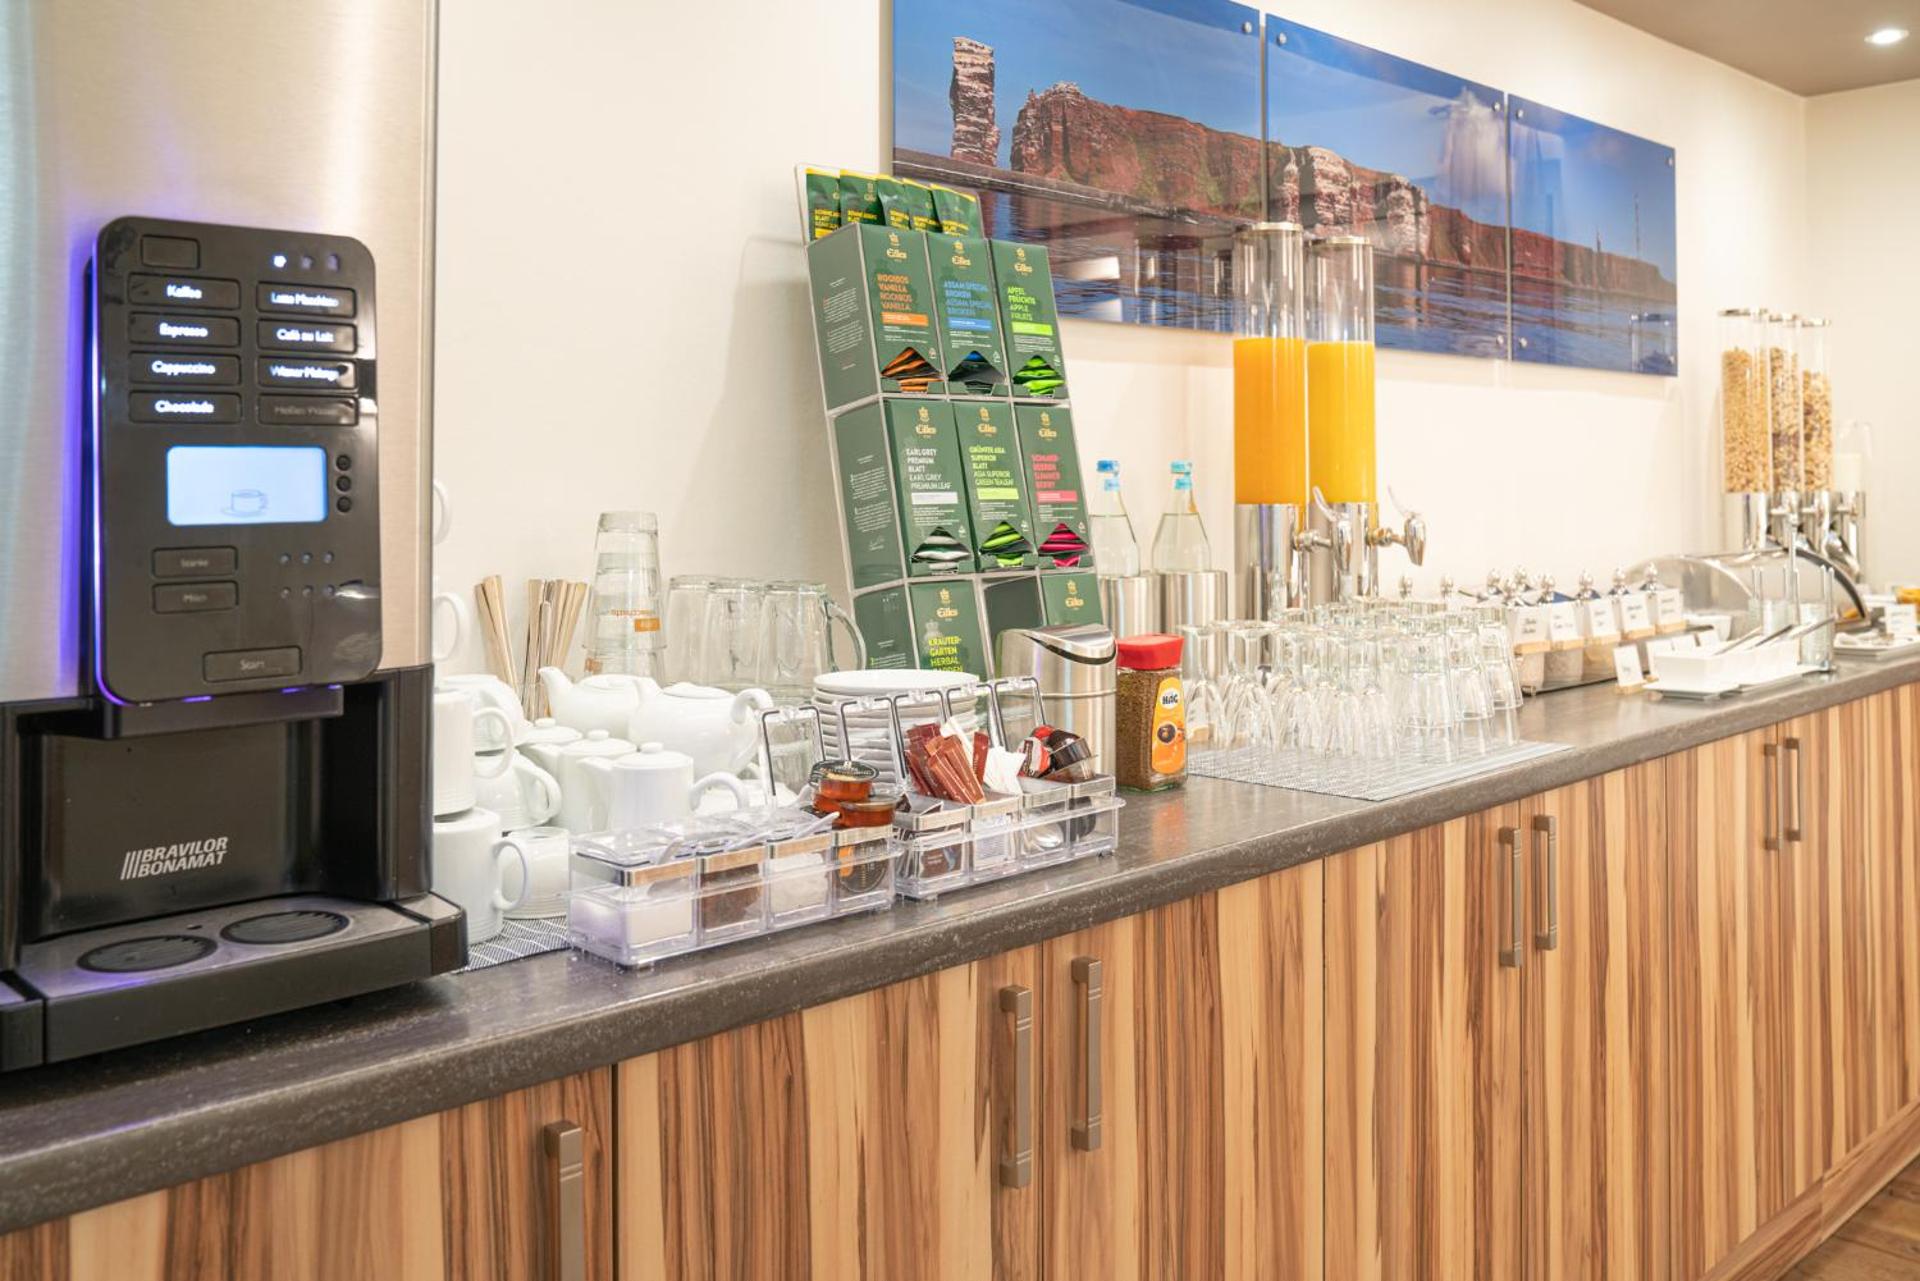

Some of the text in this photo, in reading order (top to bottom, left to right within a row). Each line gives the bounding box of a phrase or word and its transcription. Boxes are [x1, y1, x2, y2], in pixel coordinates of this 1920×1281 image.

[167, 284, 203, 299] Kaffee
[159, 323, 209, 338] Espresso
[151, 360, 216, 376] Cappuccino
[142, 836, 229, 863] BRAVILOR
[138, 850, 228, 878] BONAMAT
